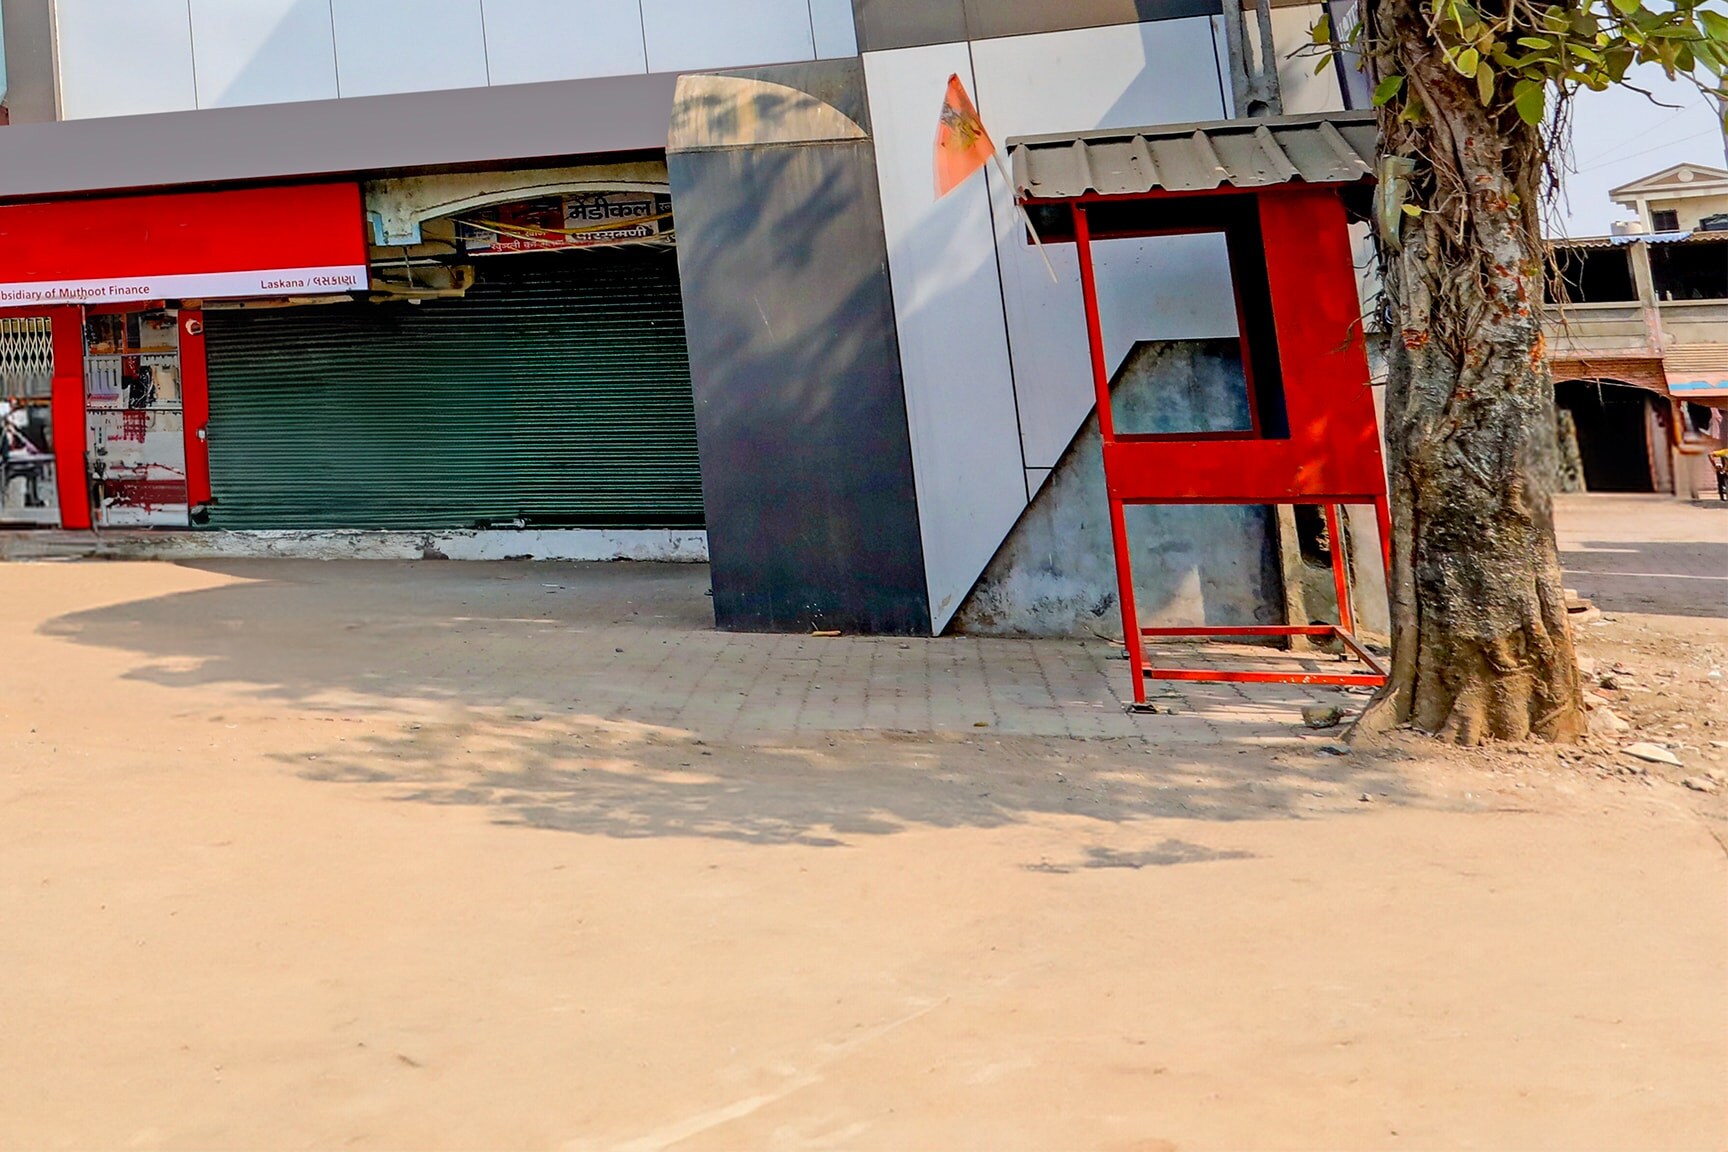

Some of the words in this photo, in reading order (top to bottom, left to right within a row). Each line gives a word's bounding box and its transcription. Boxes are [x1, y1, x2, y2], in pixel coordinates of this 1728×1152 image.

[261, 278, 304, 289] Laskana
[45, 288, 56, 298] of
[59, 286, 105, 298] Muthoot
[109, 285, 150, 295] Finance
